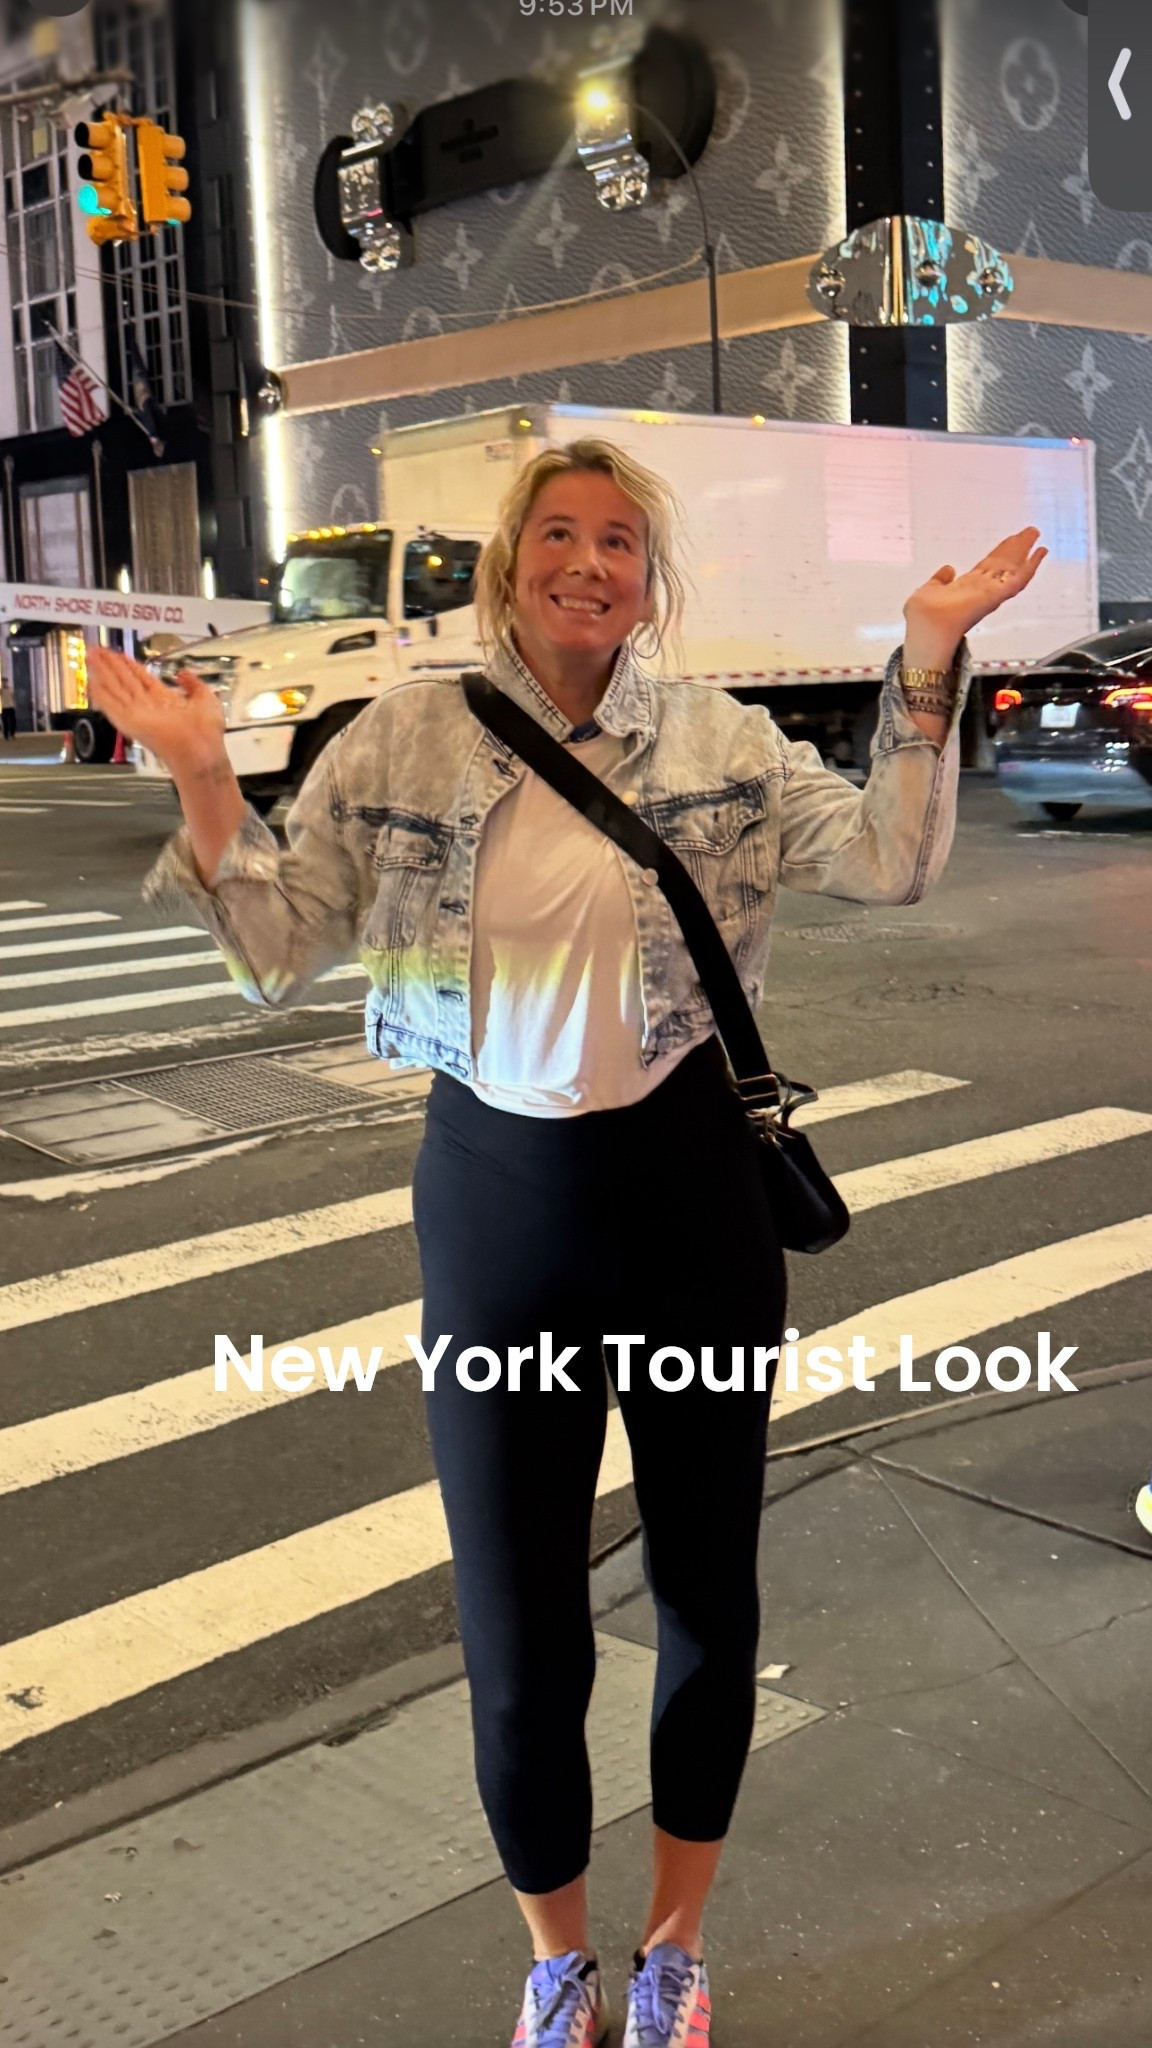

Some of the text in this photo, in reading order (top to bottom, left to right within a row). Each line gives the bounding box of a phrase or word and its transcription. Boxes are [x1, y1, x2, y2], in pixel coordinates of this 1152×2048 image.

[15, 594, 184, 623] NORTH SHORE NEON SIGN CO.
